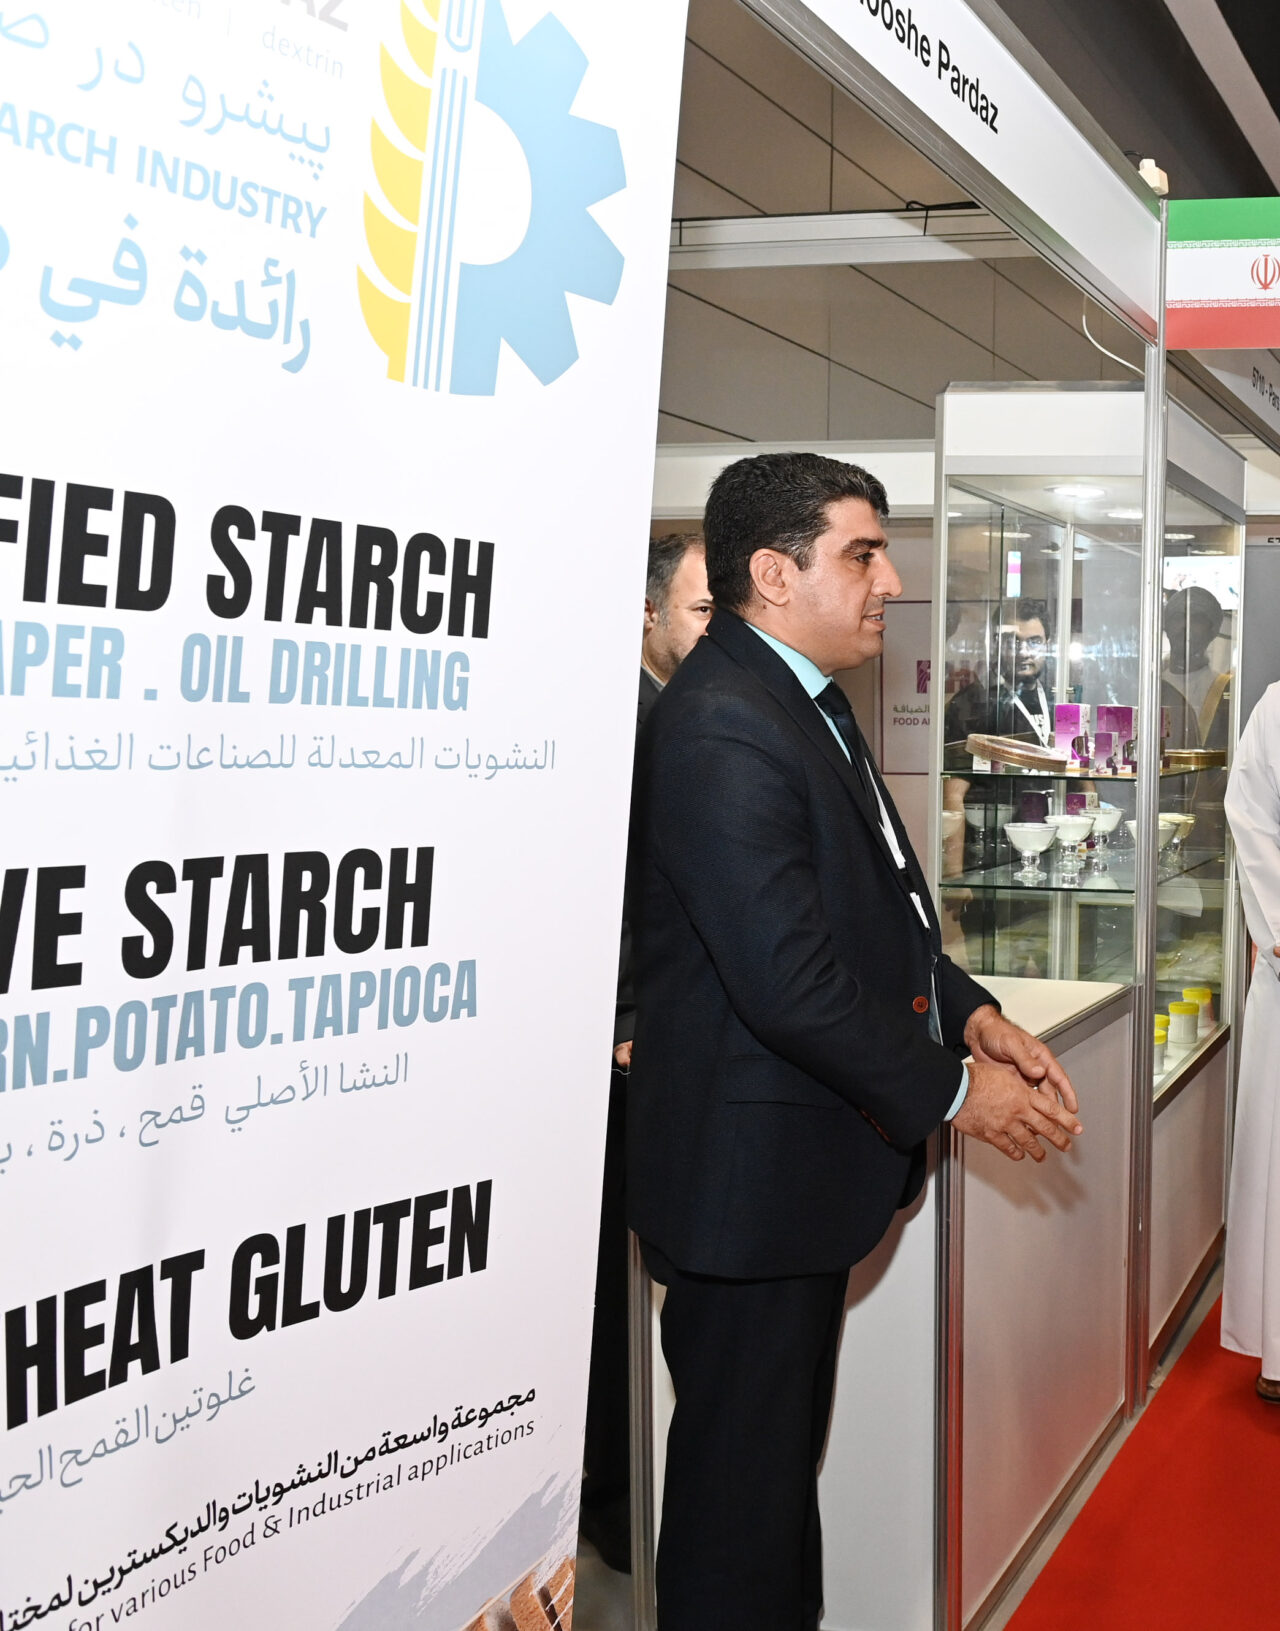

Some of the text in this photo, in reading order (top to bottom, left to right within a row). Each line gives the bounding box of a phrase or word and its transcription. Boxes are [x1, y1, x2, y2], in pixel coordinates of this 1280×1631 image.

[76, 40, 146, 92] در
[262, 25, 344, 80] dextrin
[937, 39, 998, 134] Pardaz
[136, 145, 327, 239] INDUSTRY
[39, 212, 311, 374] رائدة في
[206, 504, 496, 640] STARCH
[0, 619, 126, 700] PER
[180, 632, 251, 703] OIL
[268, 638, 471, 712] DRILLING
[148, 733, 297, 771] للصناعات
[307, 734, 424, 770] المعدلة
[893, 717, 919, 726] FOOD
[434, 737, 556, 781] النشويات
[120, 846, 435, 979] STARCH
[225, 1059, 328, 1133] الأصلي
[339, 1051, 409, 1093] النشا
[5, 1178, 493, 1431] HEAT GLUTEN
[155, 1367, 256, 1444] غلوتين
[378, 1414, 449, 1457] واسعة
[450, 1388, 536, 1430] مجموعة
[59, 1403, 149, 1488] القمح
[339, 1446, 376, 1479] من
[231, 1449, 339, 1512] النشويات
[110, 1562, 197, 1624] various
[203, 1522, 256, 1572] Food
[262, 1514, 282, 1539] &
[289, 1464, 401, 1528] Industrial
[407, 1419, 535, 1483] applications
